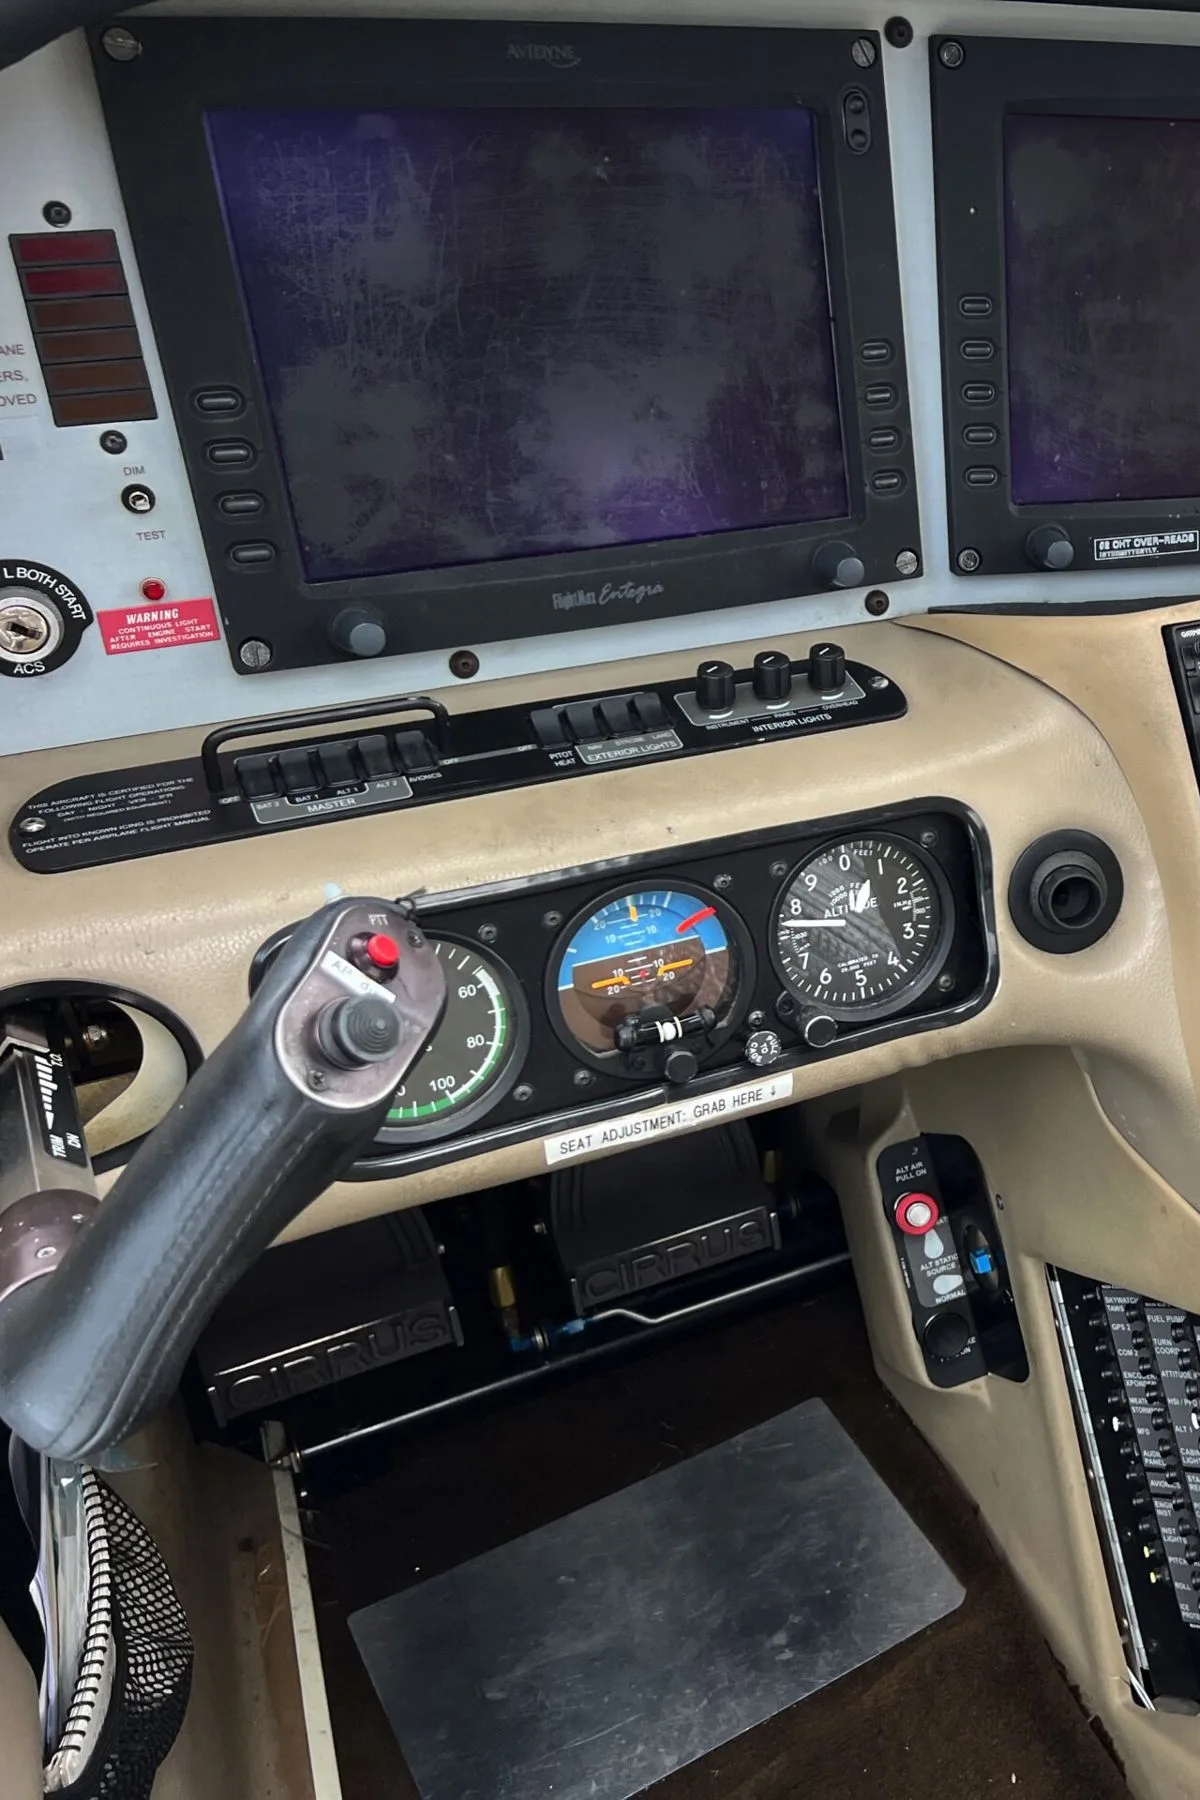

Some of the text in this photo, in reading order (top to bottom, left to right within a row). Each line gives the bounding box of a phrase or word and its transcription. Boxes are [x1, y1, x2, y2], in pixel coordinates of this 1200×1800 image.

[123, 466, 146, 477] DIM
[136, 530, 166, 542] TEST
[16, 567, 87, 621] BOTH START
[599, 581, 664, 606] Entegra
[127, 608, 179, 625] WARNING
[110, 628, 176, 643] AFTER ENGINE
[118, 621, 172, 635] CONTINUOUS
[111, 631, 214, 651] REQUIRES INVESTIGATION
[14, 661, 46, 675] ACS
[822, 700, 858, 711] OVERHEAD
[706, 718, 750, 731] INSTRUMENT
[752, 713, 832, 733] INTERIOR LIGHTS
[549, 750, 574, 760] PITOT
[587, 740, 678, 763] EXTERIOR LIGHTS
[554, 757, 577, 767] HEAT
[409, 771, 442, 783] AVIONICS
[27, 783, 155, 811] THIS AIRCRAFT CERTIFIED
[38, 785, 186, 815] FOLLOWING FLIGHT OPERATIONS
[307, 796, 356, 813] MASTER
[88, 803, 116, 812] NIGHT
[22, 809, 211, 848] FLIGHT INTO KNOWN ICING PROHIBITED
[25, 816, 211, 854] OPERATE AIRPLANE FLIGHT MANUAL
[839, 854, 851, 871] 0
[877, 858, 883, 875] 1
[804, 874, 818, 892] 9
[896, 877, 908, 894] 2
[791, 898, 801, 915] 8
[368, 913, 389, 927] PTT
[902, 922, 915, 940] 3
[652, 958, 664, 968] 10
[799, 952, 809, 970] 7
[887, 950, 900, 966] 4
[612, 968, 624, 977] 10
[663, 972, 675, 982] 20
[820, 967, 832, 985] 6
[855, 969, 867, 986] 5
[458, 984, 477, 999] 60
[607, 985, 620, 995] 20
[466, 1034, 485, 1048] 80
[428, 1075, 456, 1092] 100
[560, 1088, 763, 1155] SEAT ADJUSTMENT: GRAB HERE
[50, 1134, 67, 1158] TRIM
[895, 1161, 923, 1176] ALT AIR
[895, 1167, 927, 1183] PULL ON
[583, 1219, 765, 1302] CIRRUS
[920, 1253, 959, 1272] ALT STATIC
[926, 1262, 957, 1277] SOURCE
[935, 1289, 967, 1304] NORMAL
[227, 1313, 449, 1412] CIRRUS
